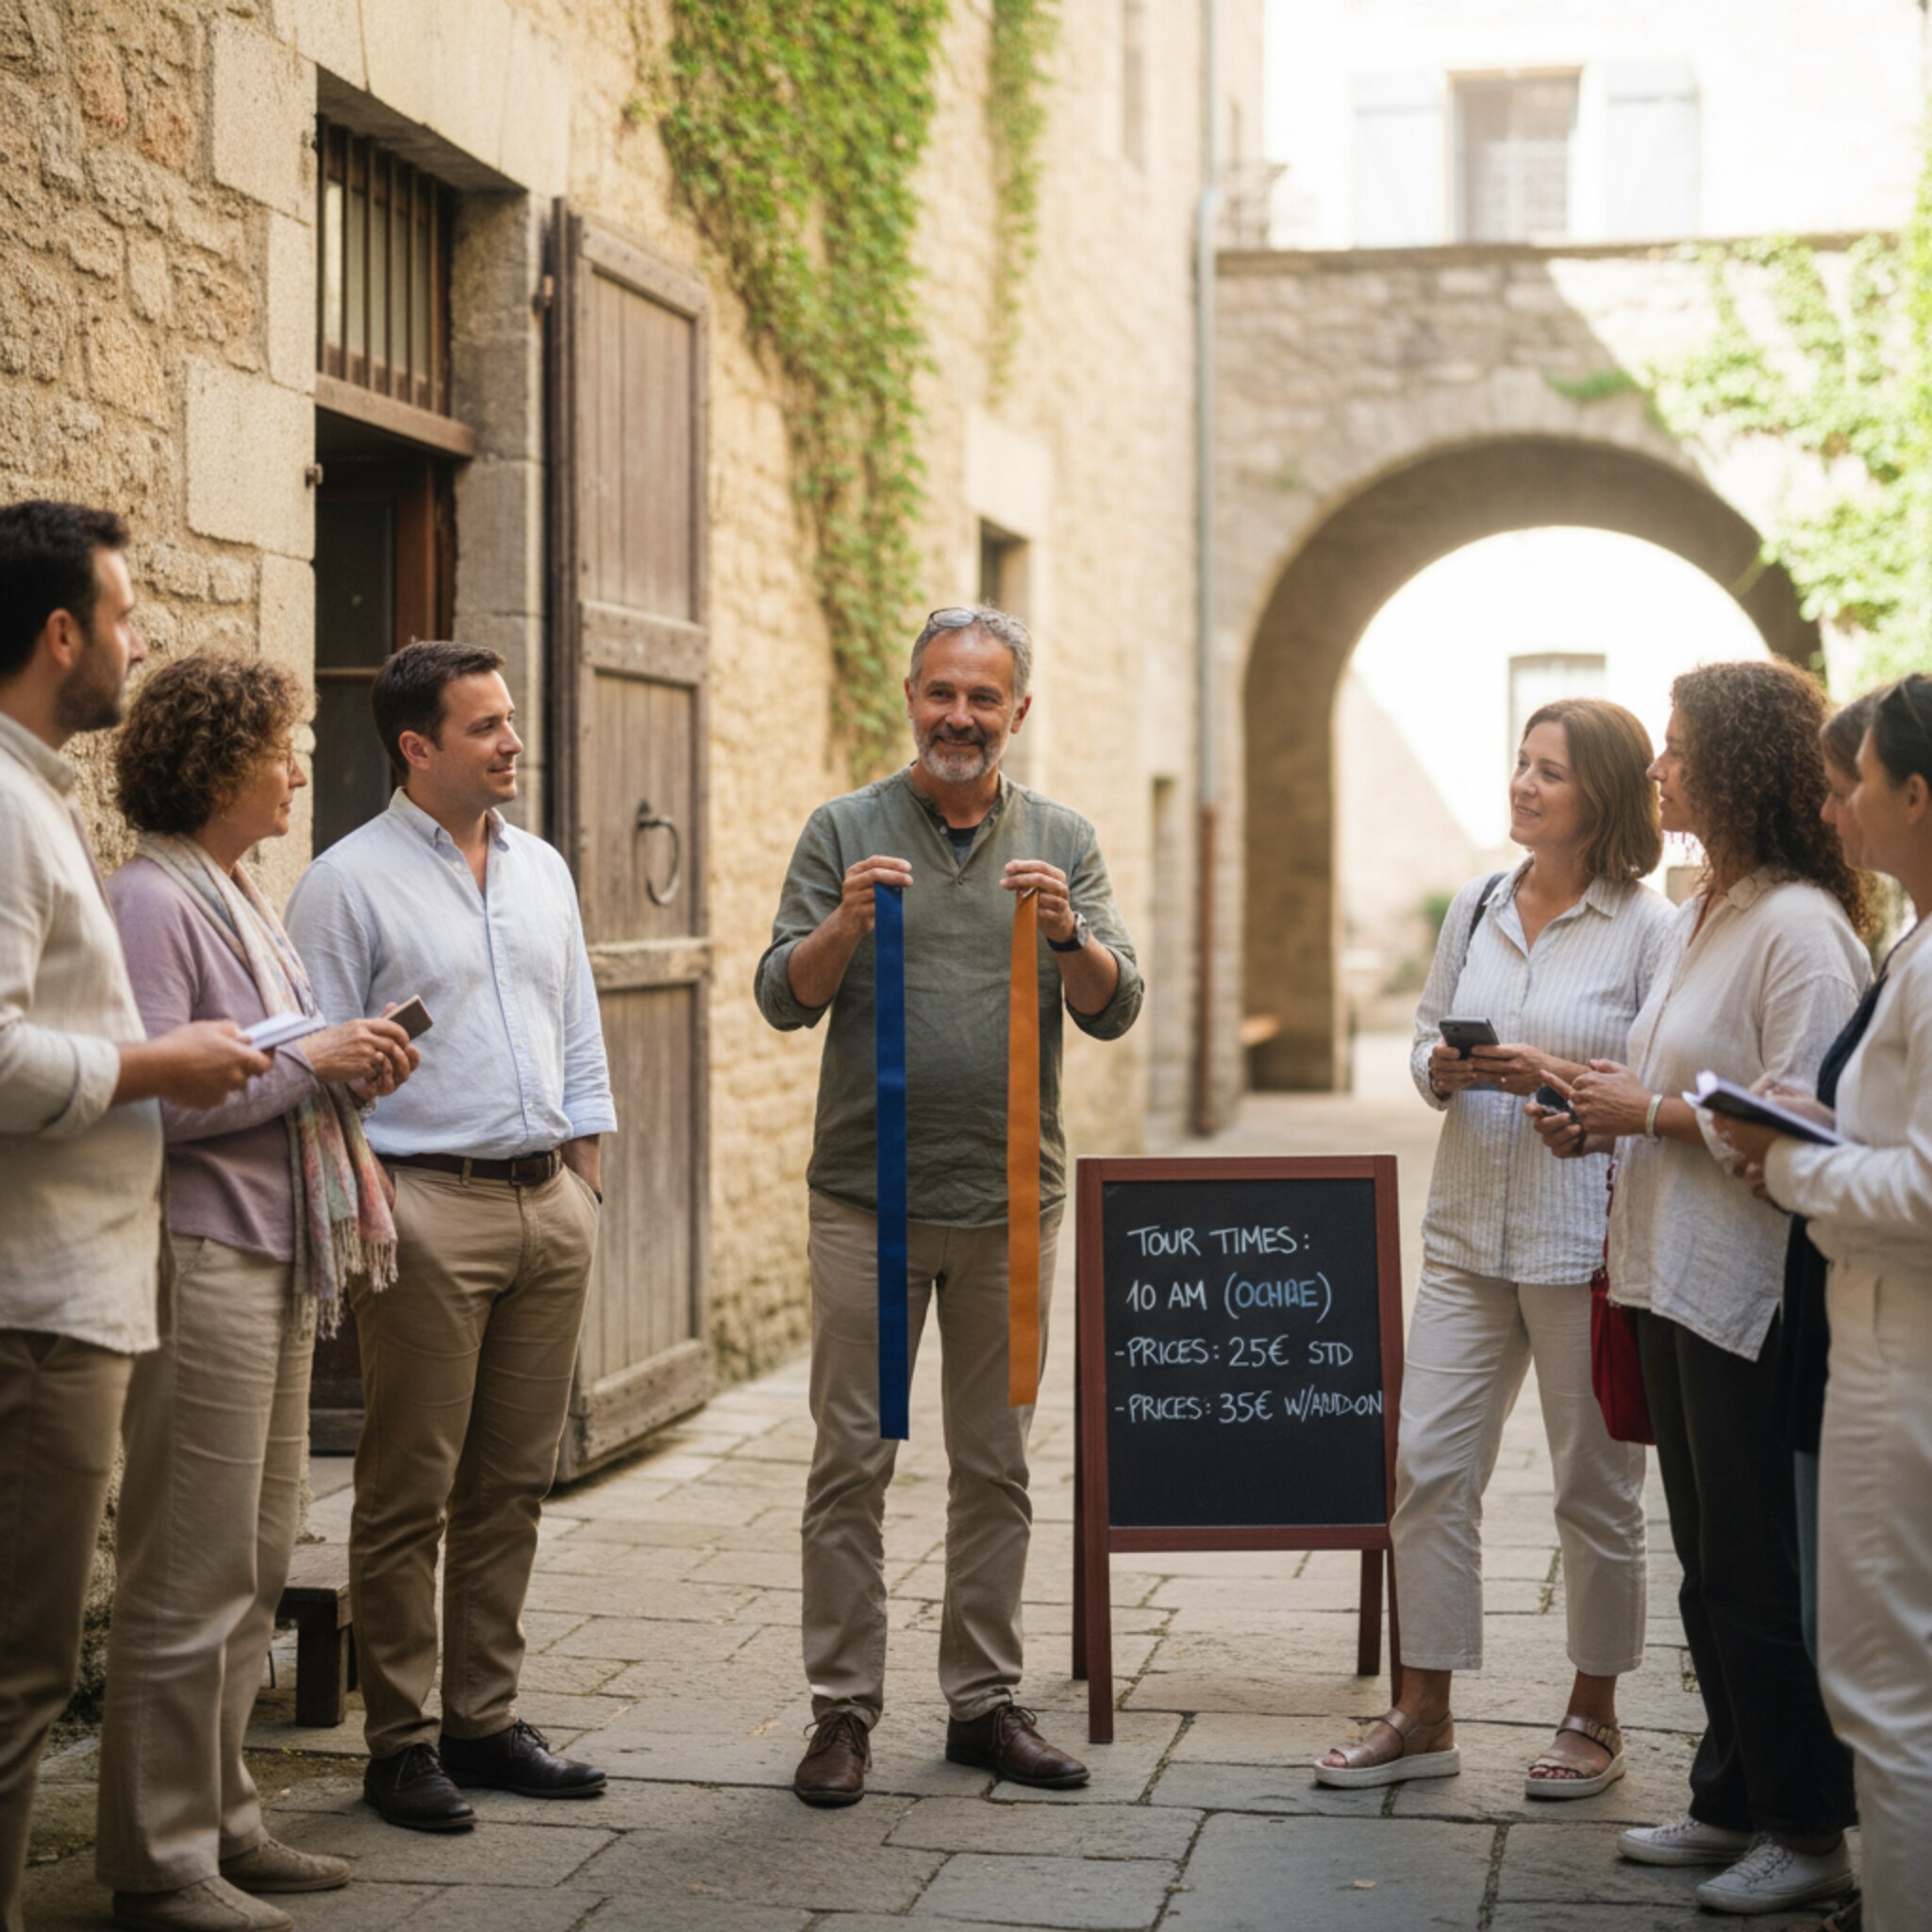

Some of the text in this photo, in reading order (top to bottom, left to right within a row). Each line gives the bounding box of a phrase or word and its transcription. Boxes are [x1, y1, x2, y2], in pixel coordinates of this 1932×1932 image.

[1126, 1225, 1310, 1256] TOUR TIMES:
[1126, 1279, 1157, 1312] 10
[1167, 1279, 1208, 1310] AM
[1228, 1334, 1290, 1367] 25€
[1307, 1341, 1354, 1367] STD
[1219, 1390, 1274, 1424] 35€
